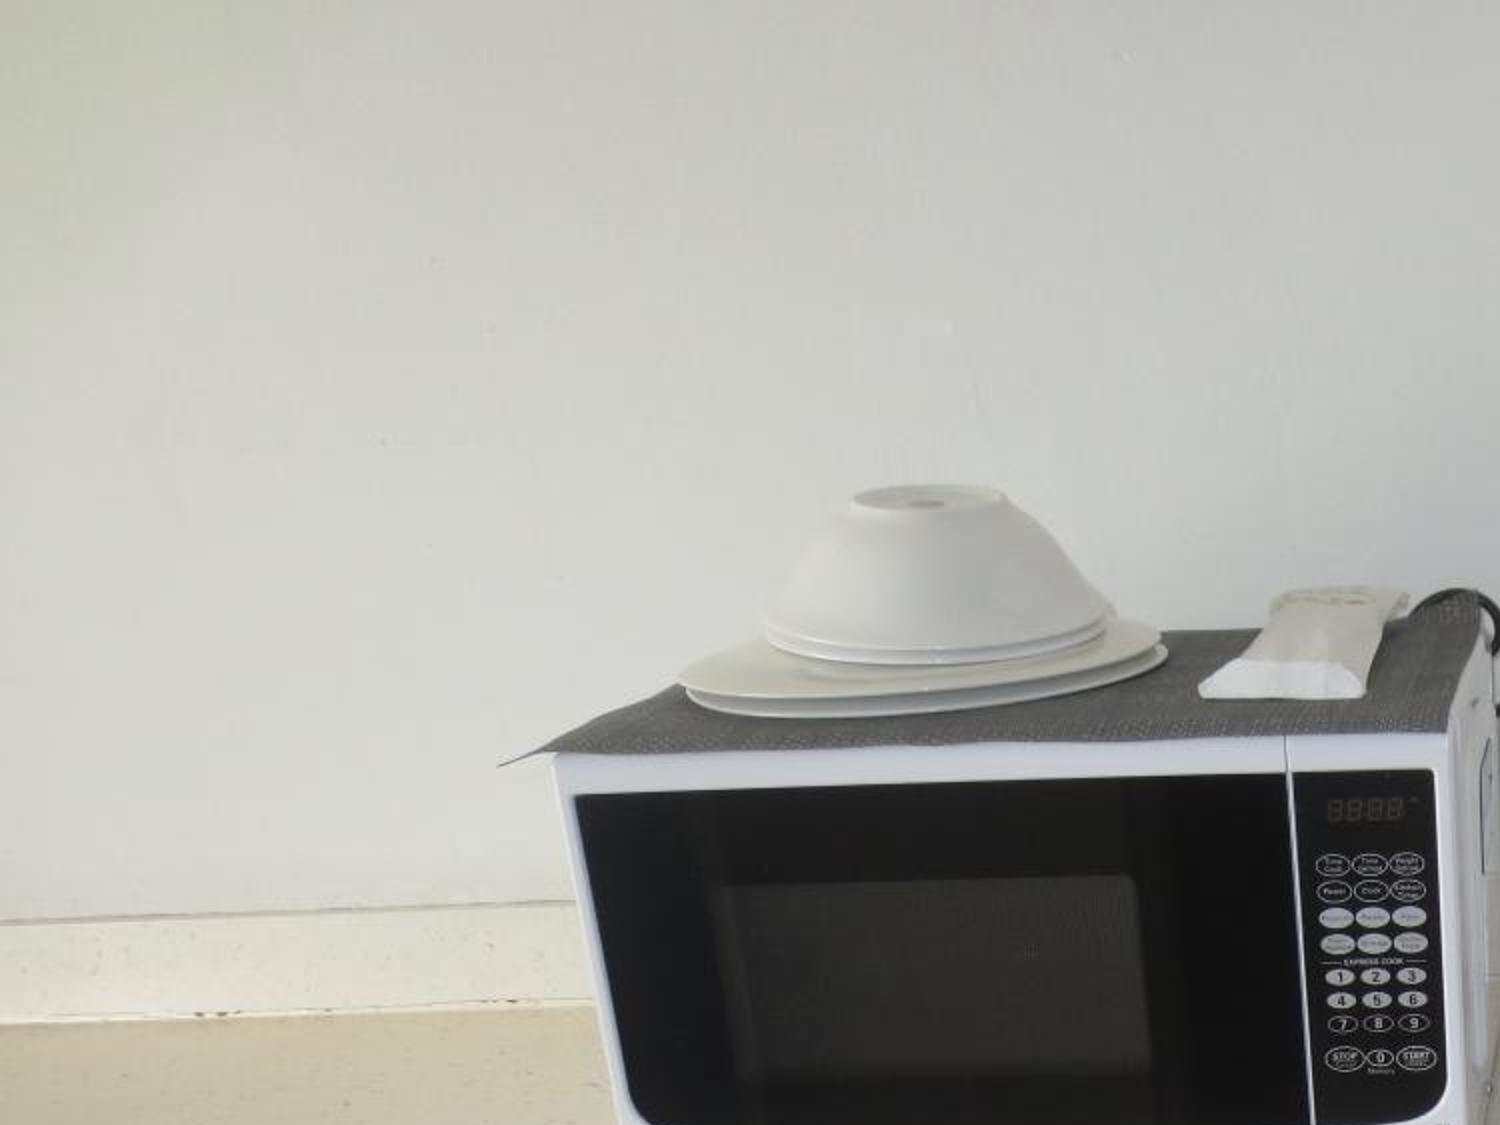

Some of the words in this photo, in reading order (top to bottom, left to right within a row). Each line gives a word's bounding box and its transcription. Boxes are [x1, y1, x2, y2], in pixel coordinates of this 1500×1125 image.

[1381, 957, 1404, 965] COOK
[1371, 971, 1380, 982] 2
[1408, 970, 1417, 981] 3
[1337, 995, 1345, 1006] 4
[1373, 994, 1382, 1006] 5
[1409, 993, 1418, 1005] 6
[1337, 1019, 1347, 1031] 7
[1374, 1017, 1383, 1029] 8
[1409, 1017, 1419, 1029] 9
[1332, 1051, 1358, 1060] STOP
[1377, 1051, 1385, 1063] 0
[1403, 1051, 1430, 1060] START
